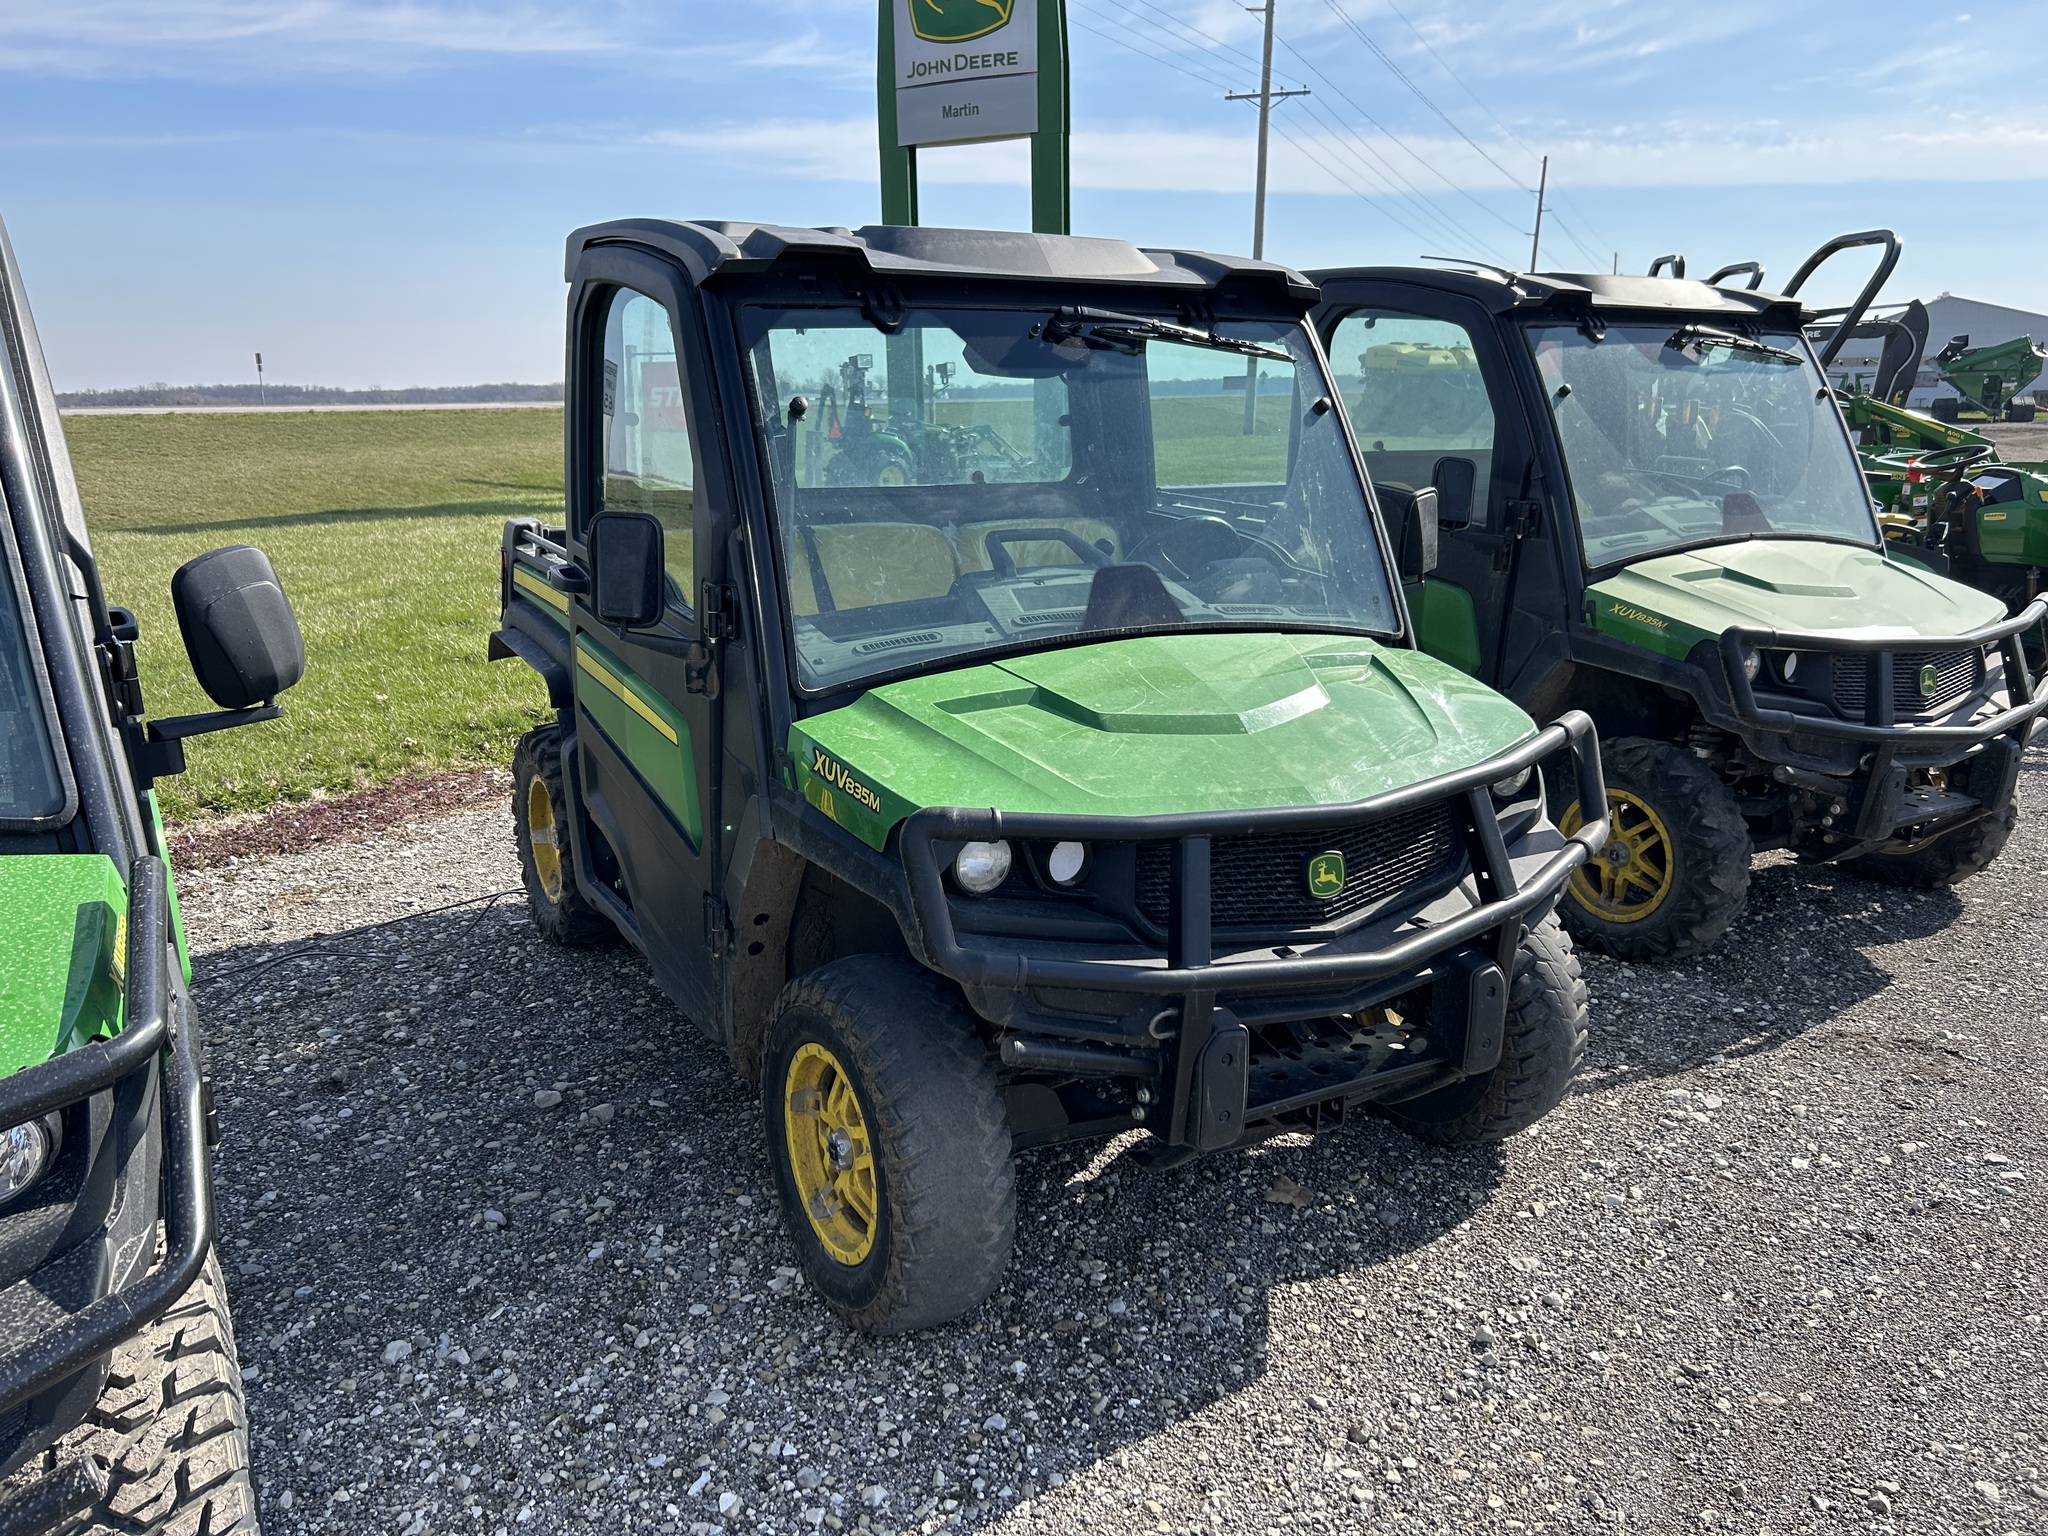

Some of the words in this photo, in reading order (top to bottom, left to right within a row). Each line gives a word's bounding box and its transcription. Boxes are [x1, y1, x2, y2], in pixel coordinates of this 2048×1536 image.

[907, 59, 951, 79] JOHN
[954, 51, 1019, 72] DEERE
[942, 103, 980, 119] Martin
[1609, 603, 1668, 629] XUV835M
[813, 748, 881, 813] XUV835M
